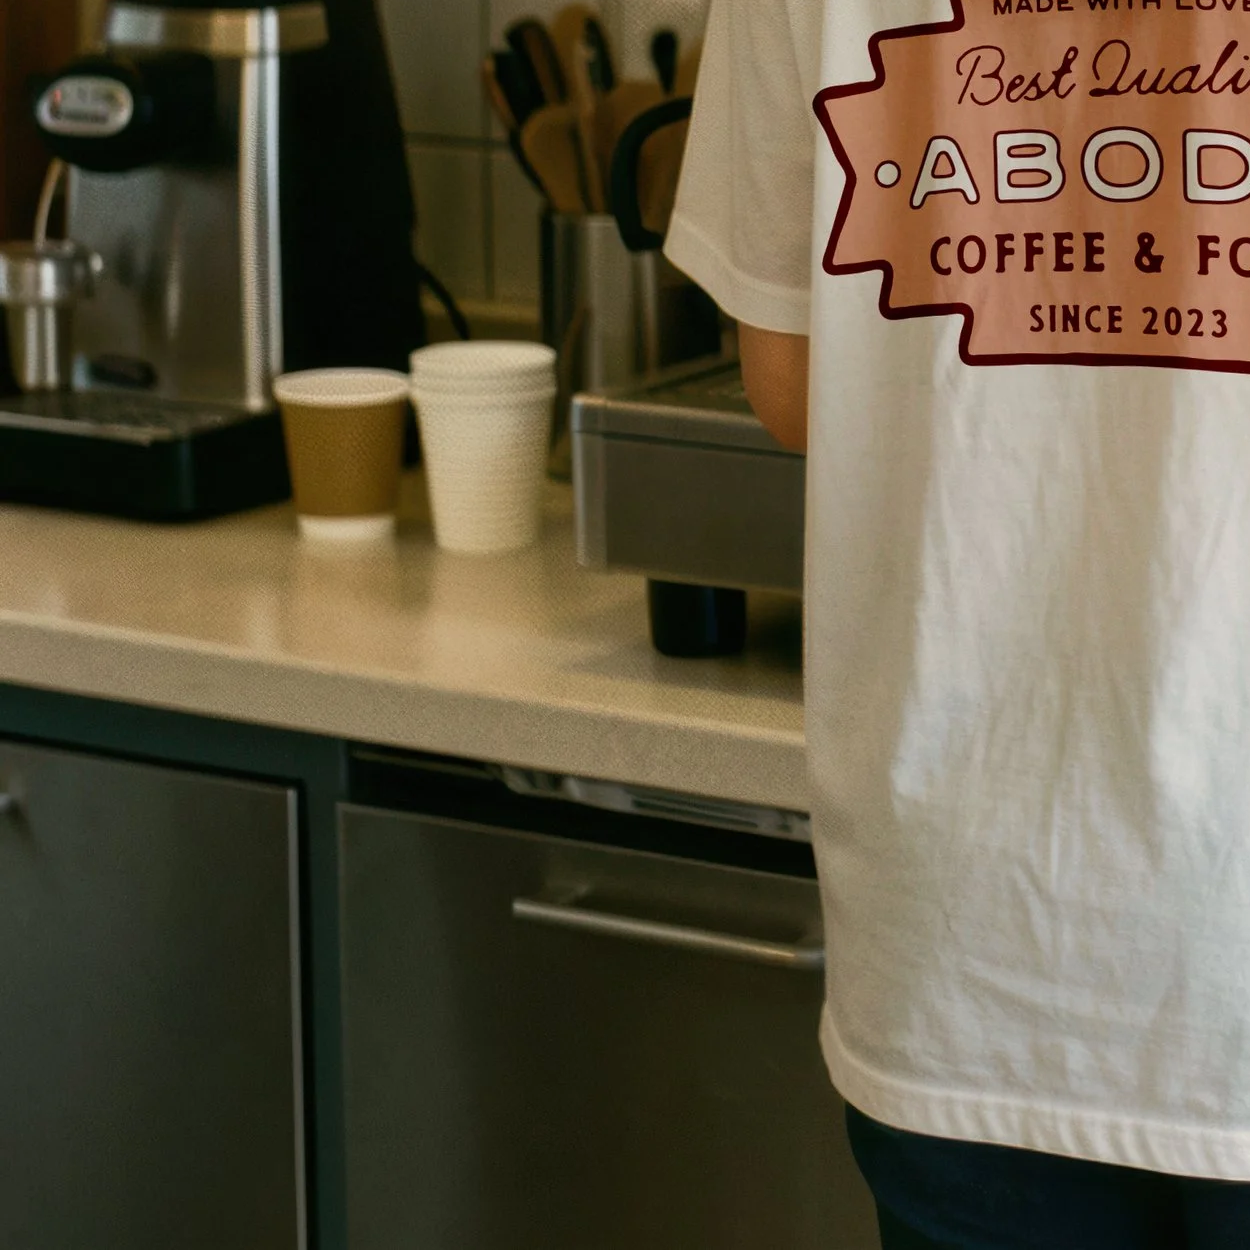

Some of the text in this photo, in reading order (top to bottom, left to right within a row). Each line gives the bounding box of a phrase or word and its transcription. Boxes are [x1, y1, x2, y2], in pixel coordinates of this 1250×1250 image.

[956, 45, 1078, 106] Best
[930, 232, 1105, 275] COFFEE
[1134, 232, 1164, 273] &
[1030, 305, 1227, 338] SINCE 2023
